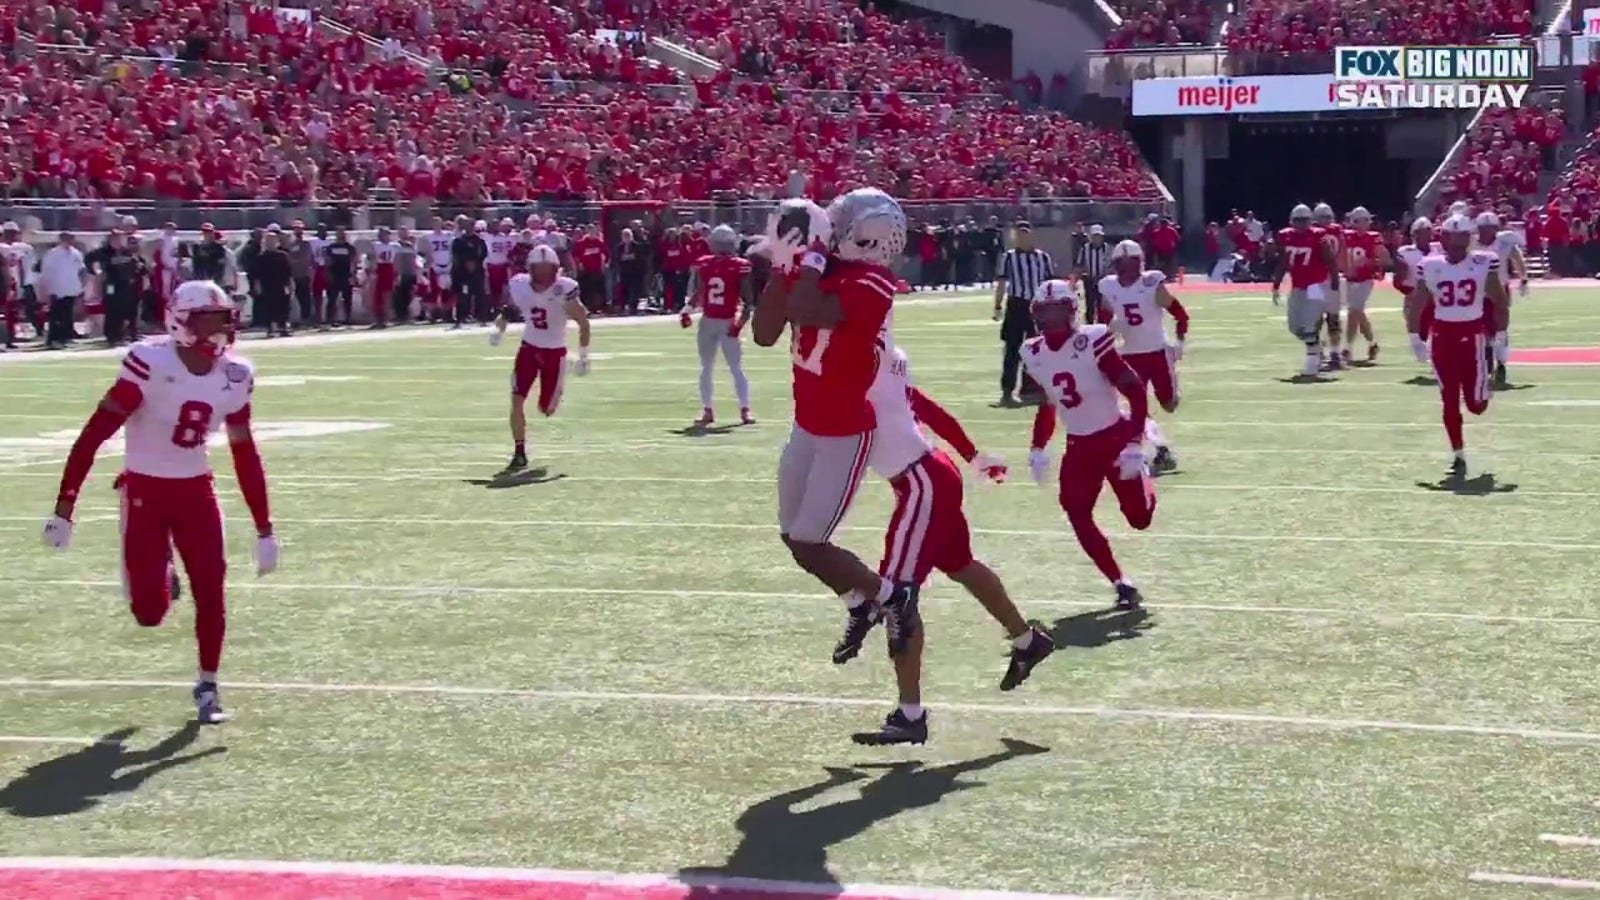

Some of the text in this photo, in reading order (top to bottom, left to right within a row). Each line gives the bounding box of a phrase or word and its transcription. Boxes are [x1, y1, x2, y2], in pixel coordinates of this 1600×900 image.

[1178, 78, 1260, 112] meijer
[1285, 246, 1312, 266] 77
[707, 277, 726, 305] 2
[1436, 278, 1477, 307] 33
[530, 306, 549, 330] 2
[1122, 303, 1144, 326] 5
[1052, 371, 1083, 409] 3
[171, 400, 214, 449] 8
